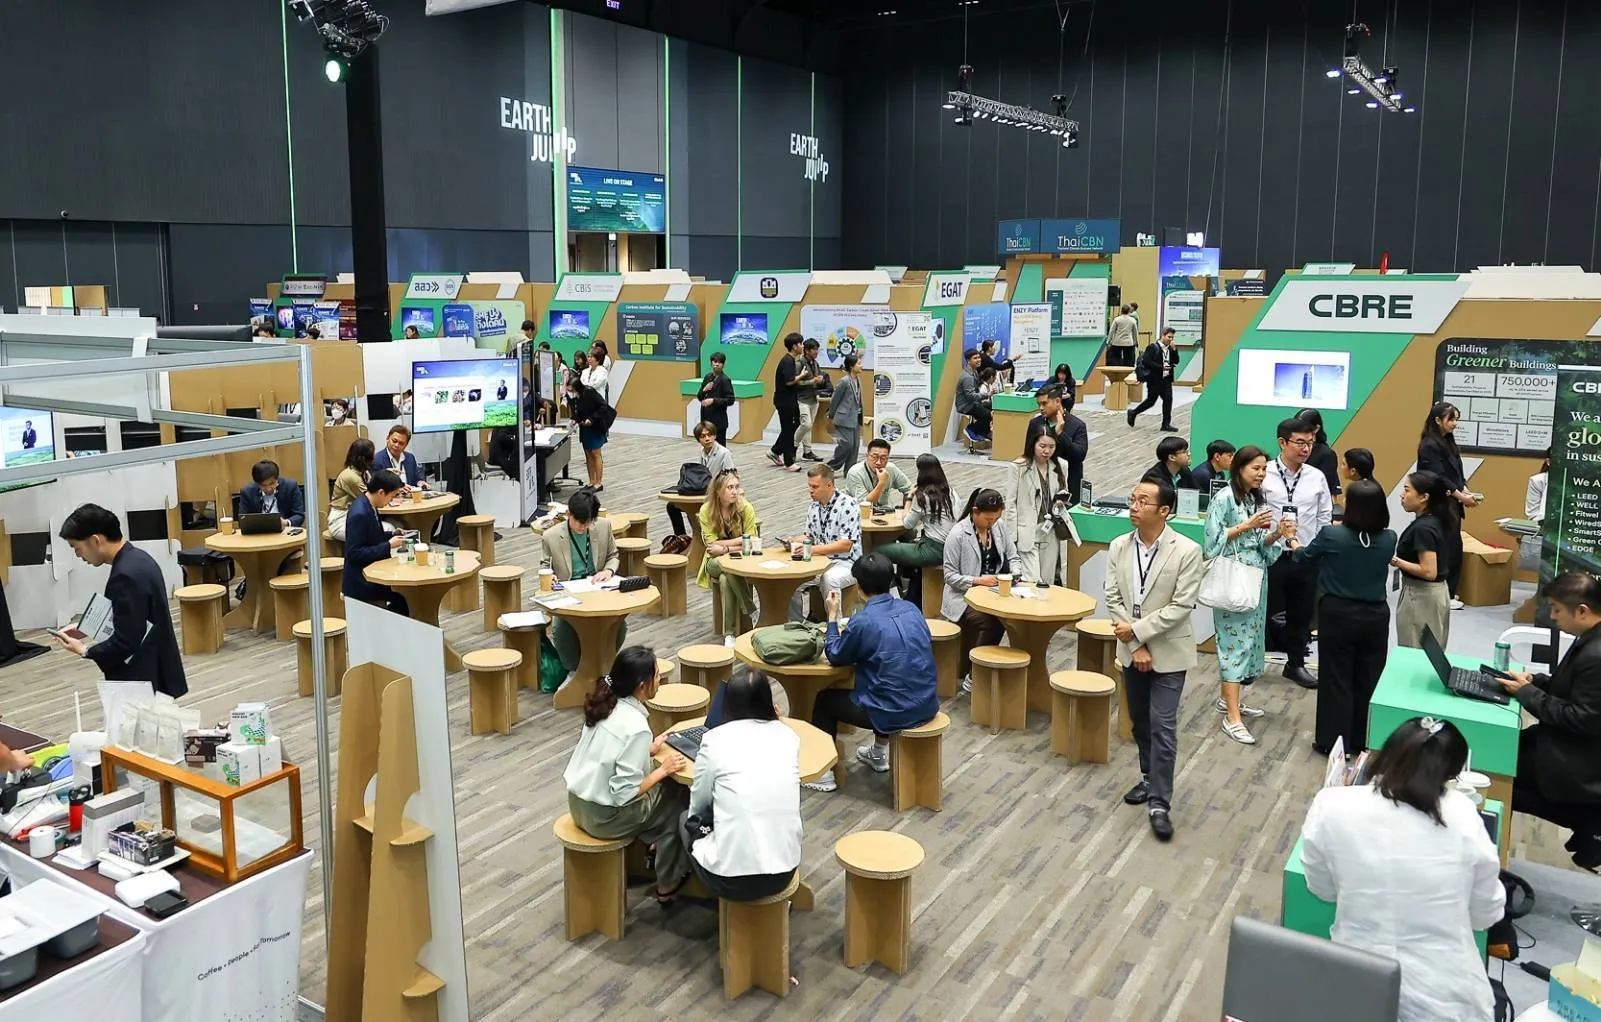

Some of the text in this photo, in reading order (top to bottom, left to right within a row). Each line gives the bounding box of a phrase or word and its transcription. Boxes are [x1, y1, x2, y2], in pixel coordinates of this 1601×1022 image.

[606, 0, 620, 10] EXIT
[500, 96, 552, 134] EARTH
[790, 132, 818, 159] EARTH
[1006, 236, 1031, 248] ThaiCBN
[1057, 234, 1104, 247] ThaiCBN
[941, 281, 963, 299] EGAT
[1308, 294, 1414, 319] CBRE
[1447, 344, 1488, 355] Building
[1446, 355, 1557, 371] Greener Buildings
[1464, 375, 1475, 384] 21
[1501, 376, 1556, 387] 750,000+
[1570, 411, 1591, 422] We
[1566, 427, 1601, 448] glo
[1566, 449, 1579, 460] in
[1573, 477, 1590, 487] We
[1576, 501, 1599, 509] WELL
[1575, 510, 1599, 519] Fitwel
[1572, 536, 1596, 544] Green
[1571, 545, 1594, 553] EDGE
